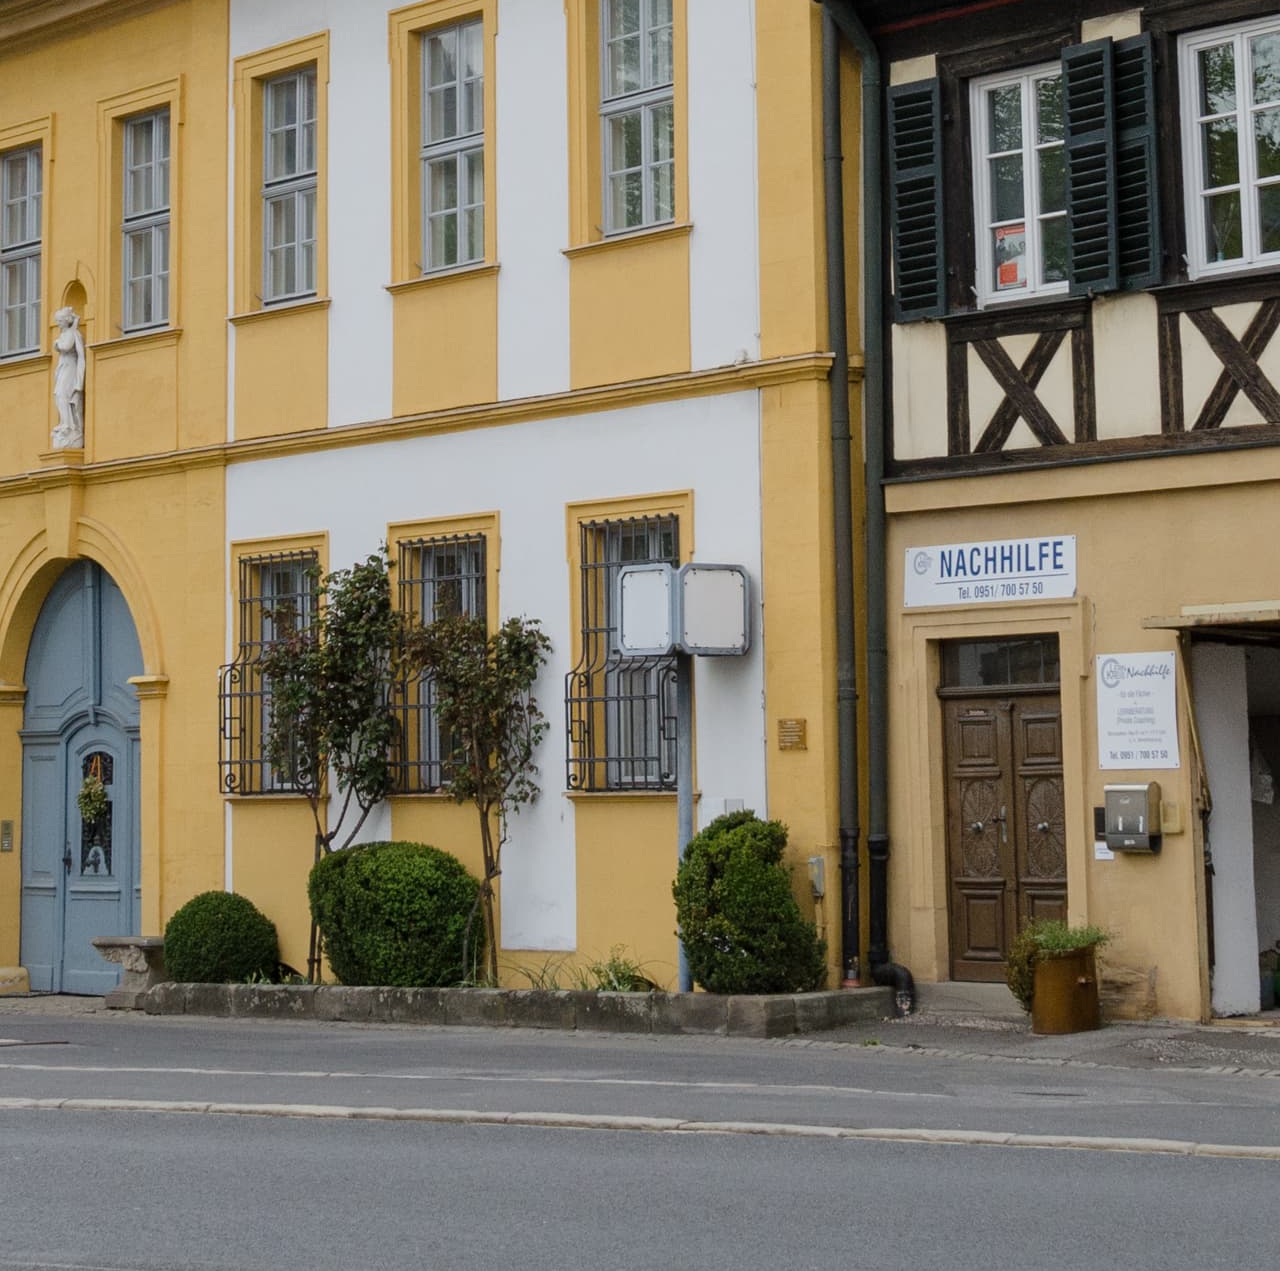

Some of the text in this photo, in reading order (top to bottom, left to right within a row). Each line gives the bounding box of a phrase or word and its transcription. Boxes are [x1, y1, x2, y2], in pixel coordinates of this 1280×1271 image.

[940, 541, 1064, 578] NACHHILFE
[958, 581, 1043, 600] Tel. 0951/ 700 57 50
[1127, 664, 1171, 680] Nachhilfe
[1110, 751, 1119, 760] Tel.
[1120, 751, 1134, 760] 0951
[1140, 750, 1150, 759] 700
[1151, 750, 1159, 759] 57
[1160, 750, 1169, 759] 50
